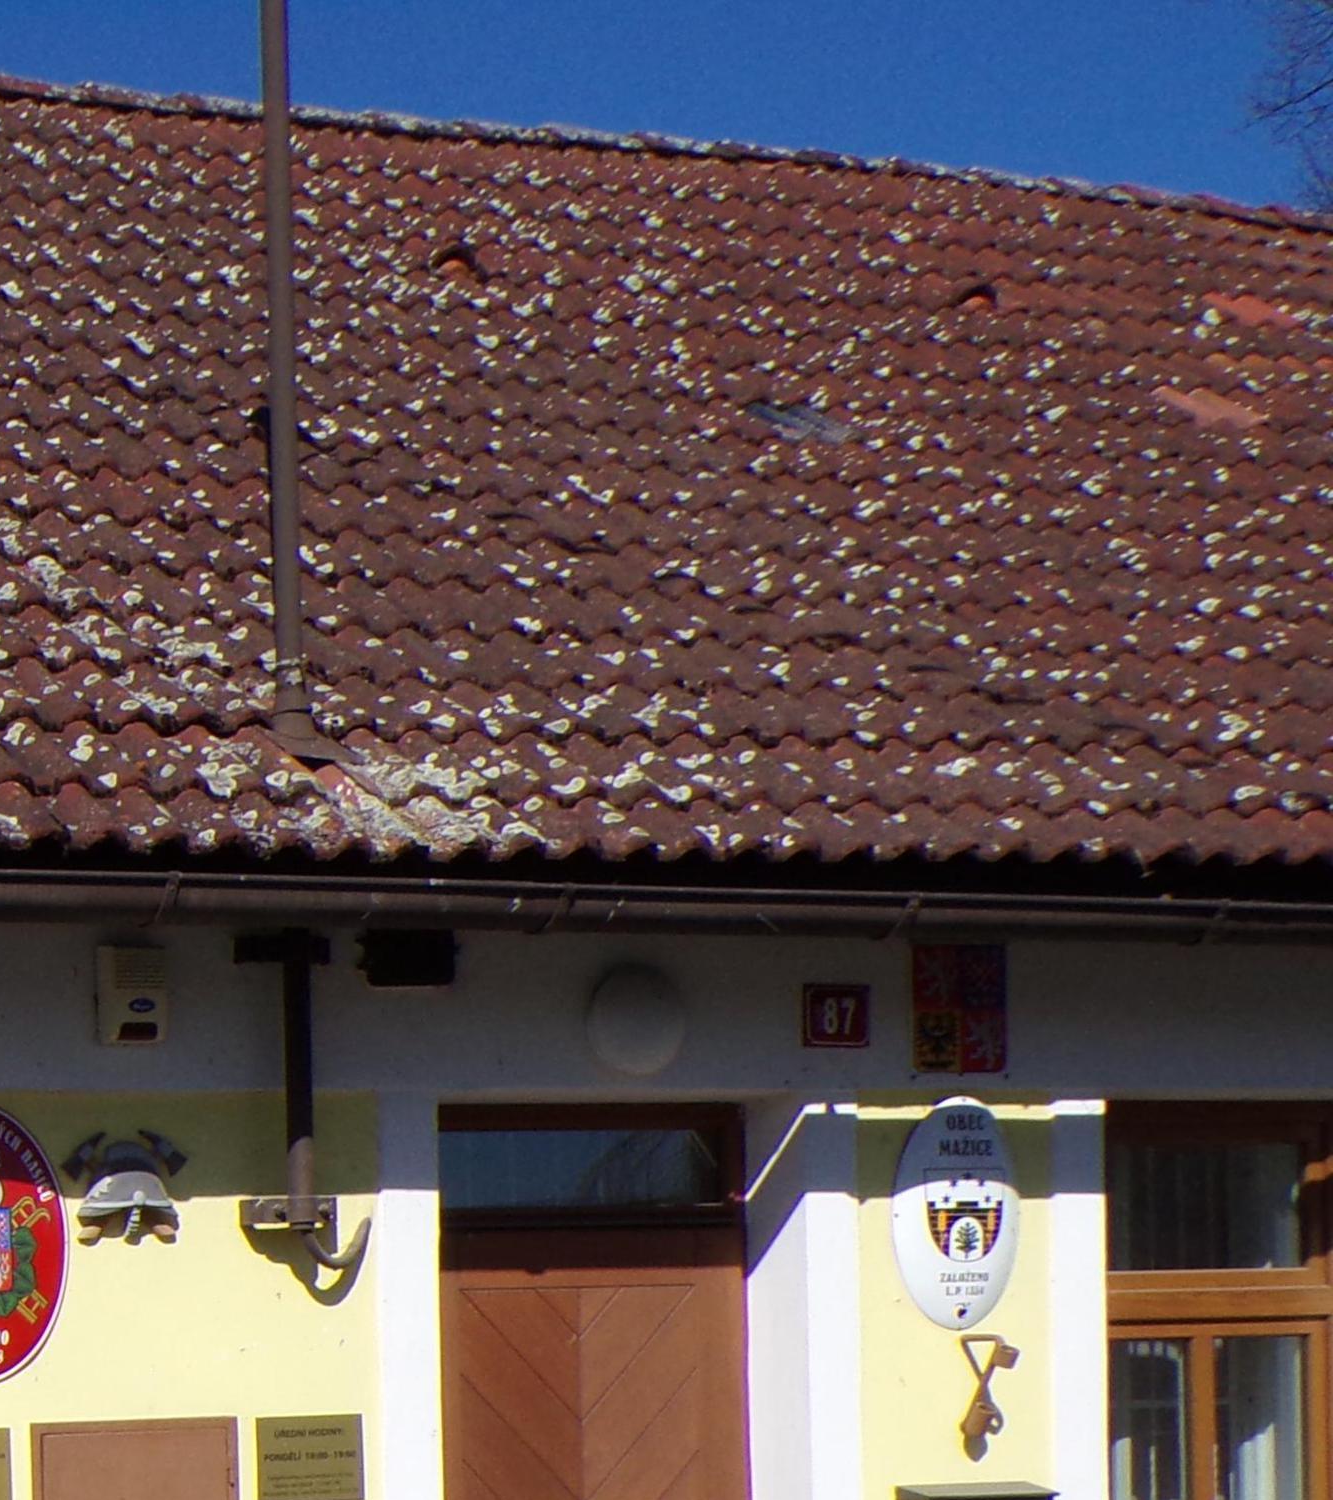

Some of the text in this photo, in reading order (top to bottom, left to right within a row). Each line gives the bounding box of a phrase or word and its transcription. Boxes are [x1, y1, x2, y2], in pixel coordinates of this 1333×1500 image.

[823, 998, 856, 1034] 87
[946, 1113, 985, 1131] OBEC
[939, 1136, 993, 1157] MAŽICE
[940, 1270, 989, 1283] ZALOŽENO
[263, 1450, 301, 1461] PONDĚLÍ
